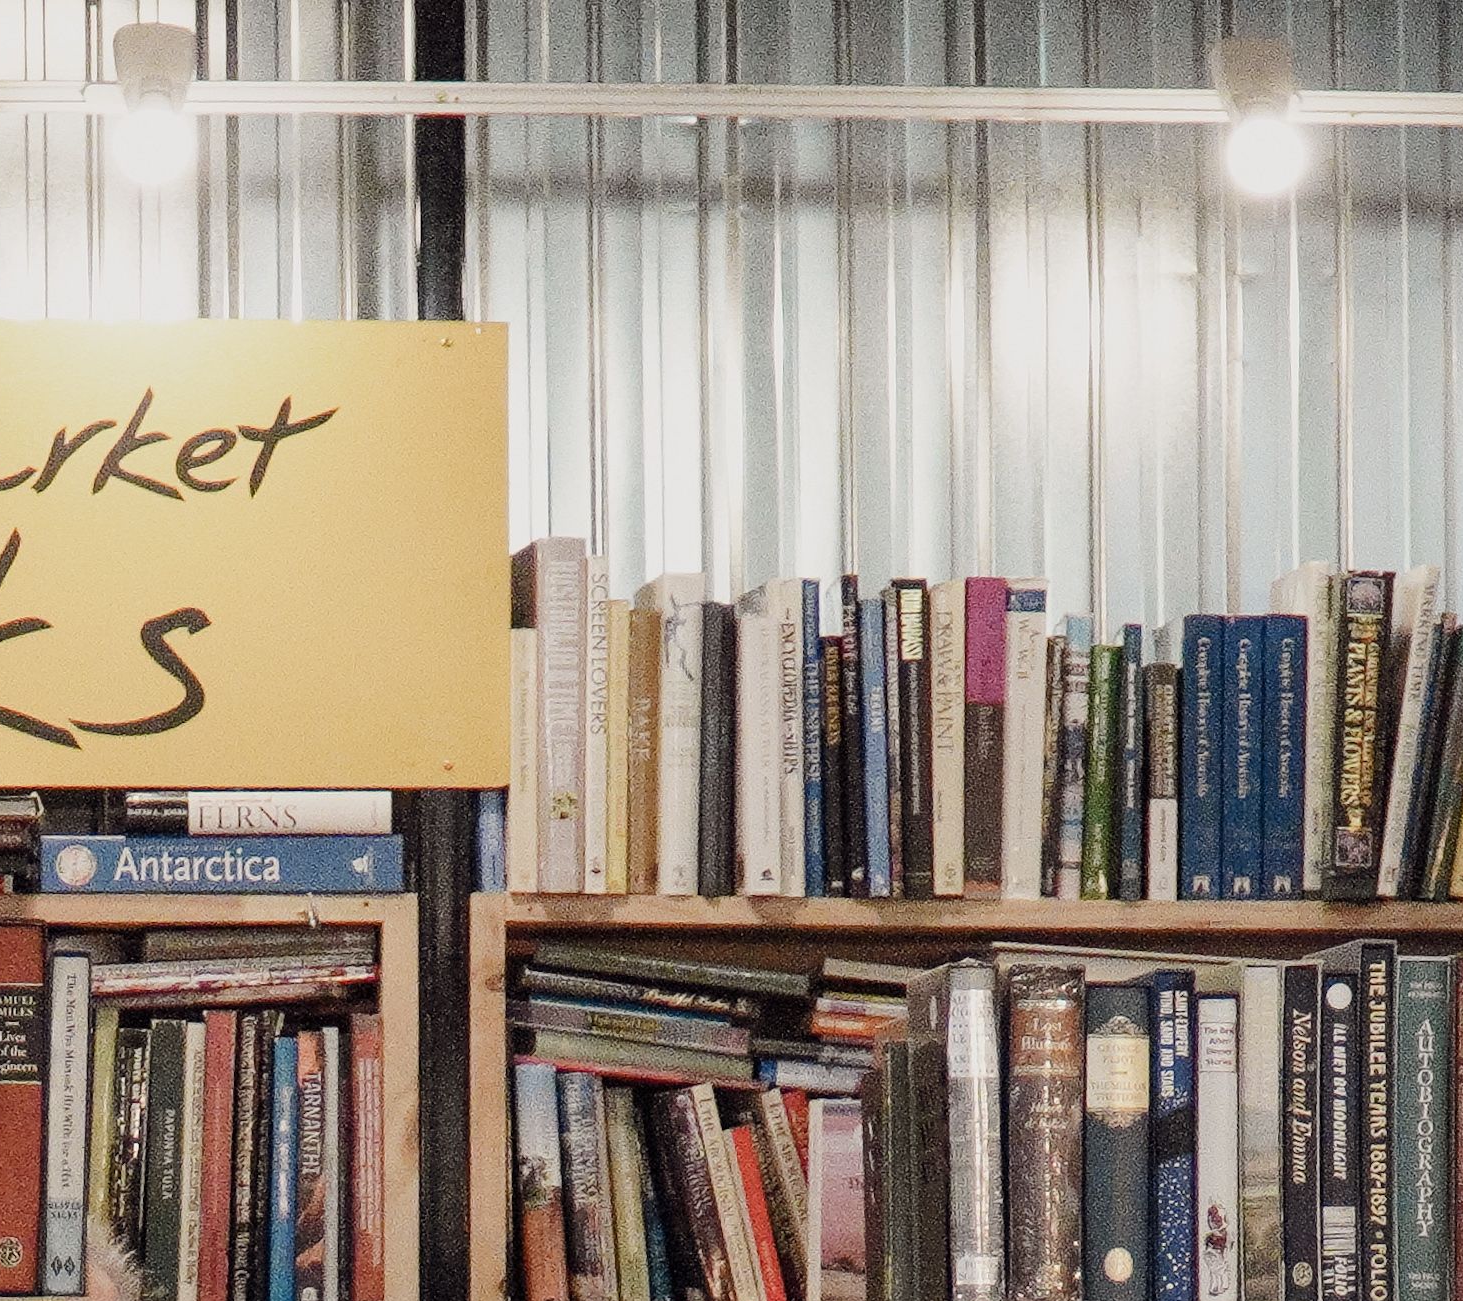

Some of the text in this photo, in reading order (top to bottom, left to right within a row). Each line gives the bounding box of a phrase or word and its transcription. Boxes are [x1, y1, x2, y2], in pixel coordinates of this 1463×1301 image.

[1344, 642, 1367, 704] PLANTS
[1341, 727, 1363, 805] FLOWERS
[114, 847, 281, 883] Antarctica
[1290, 1009, 1313, 1184] Nelson and Emma
[1369, 961, 1388, 1301] THE JUBILEE YEARS 1887-1897 FOLIO
